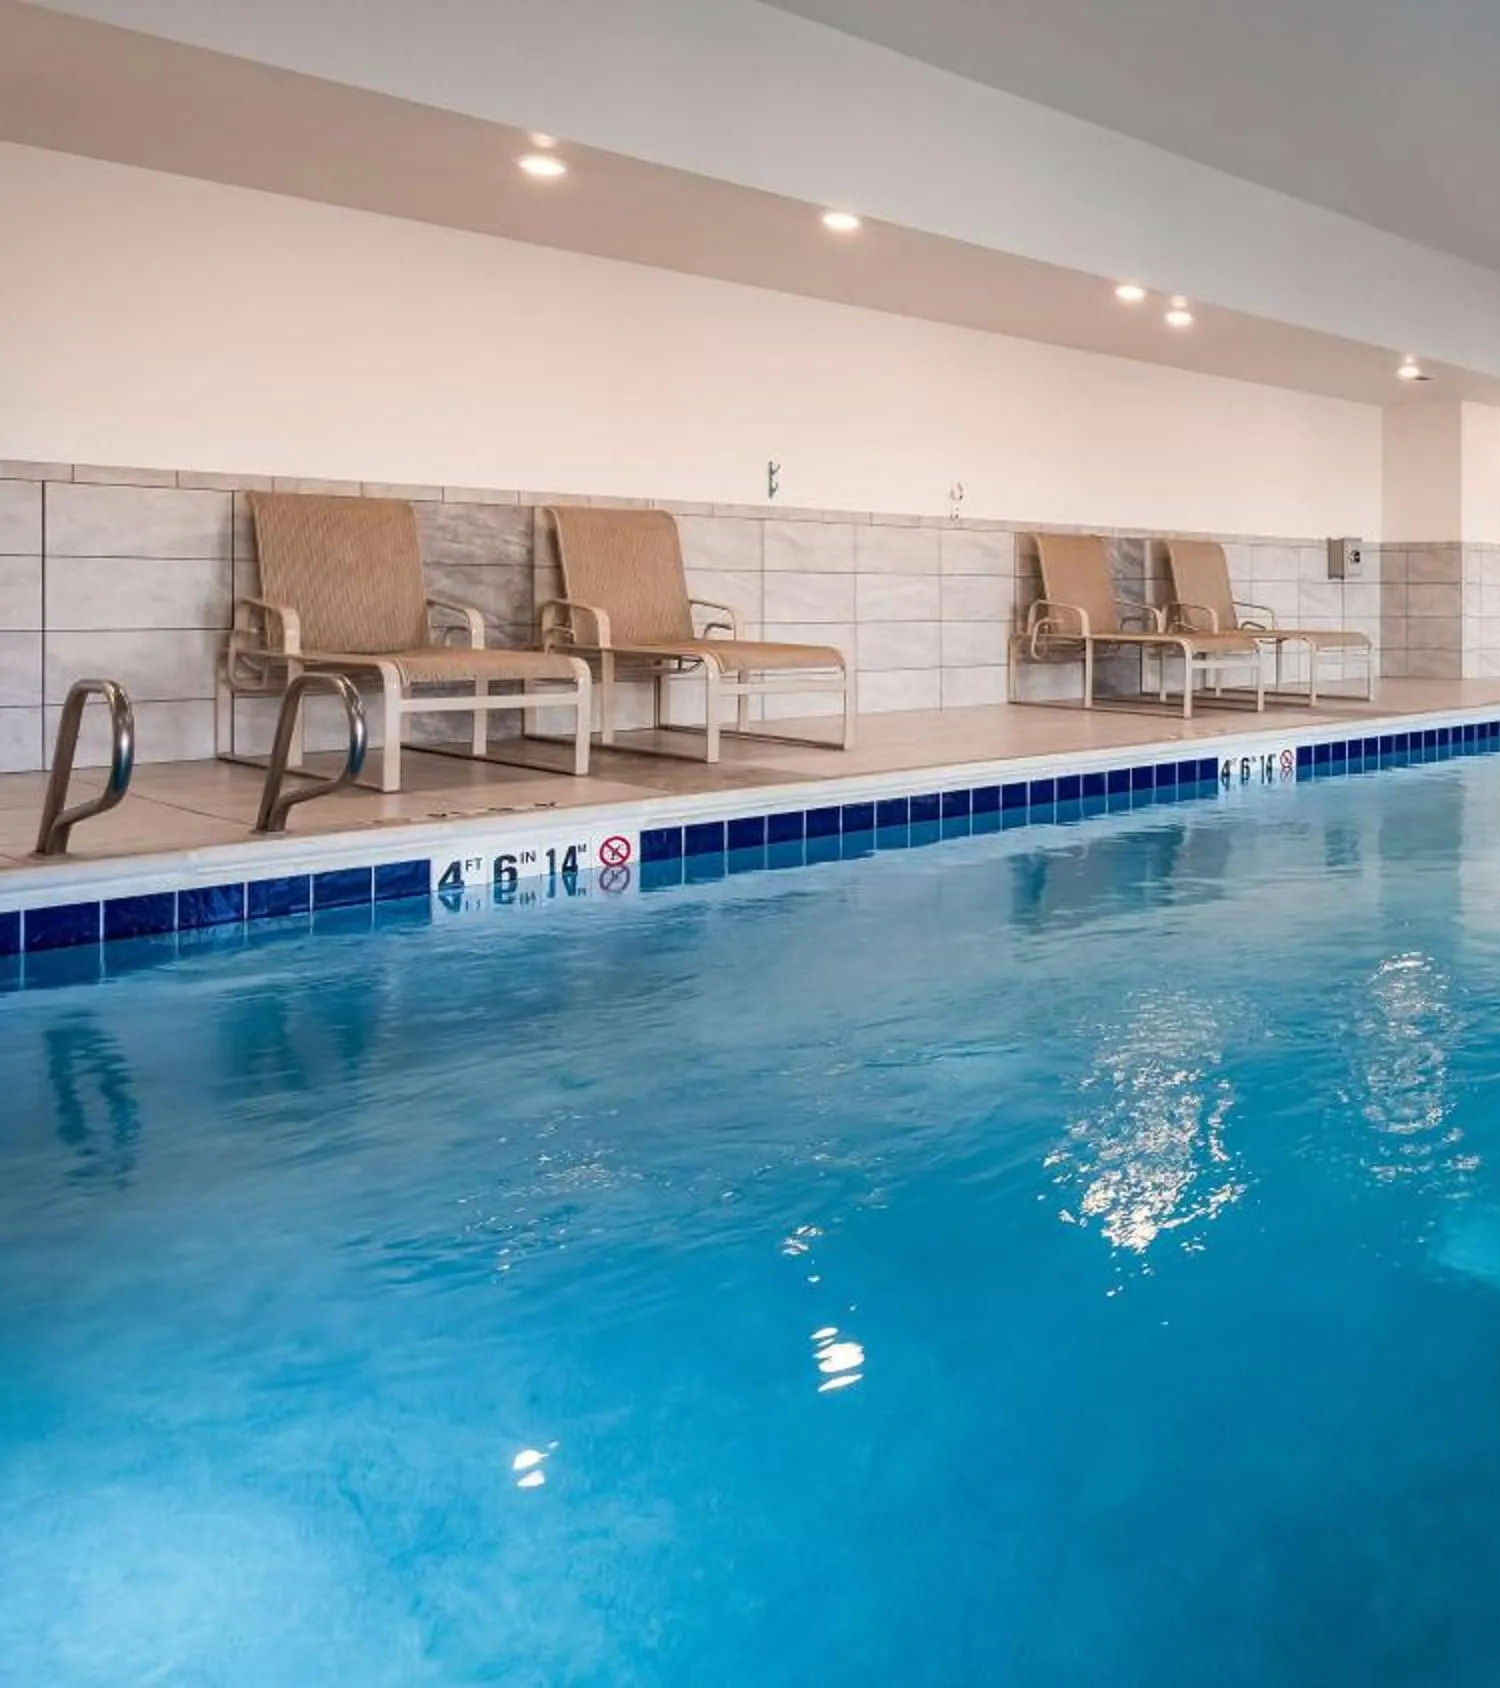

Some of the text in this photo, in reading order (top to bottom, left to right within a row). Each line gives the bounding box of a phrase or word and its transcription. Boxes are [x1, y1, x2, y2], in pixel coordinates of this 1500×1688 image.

[438, 860, 465, 891] 4
[465, 857, 483, 871] FT
[493, 854, 518, 883] 6
[519, 851, 536, 864] IN
